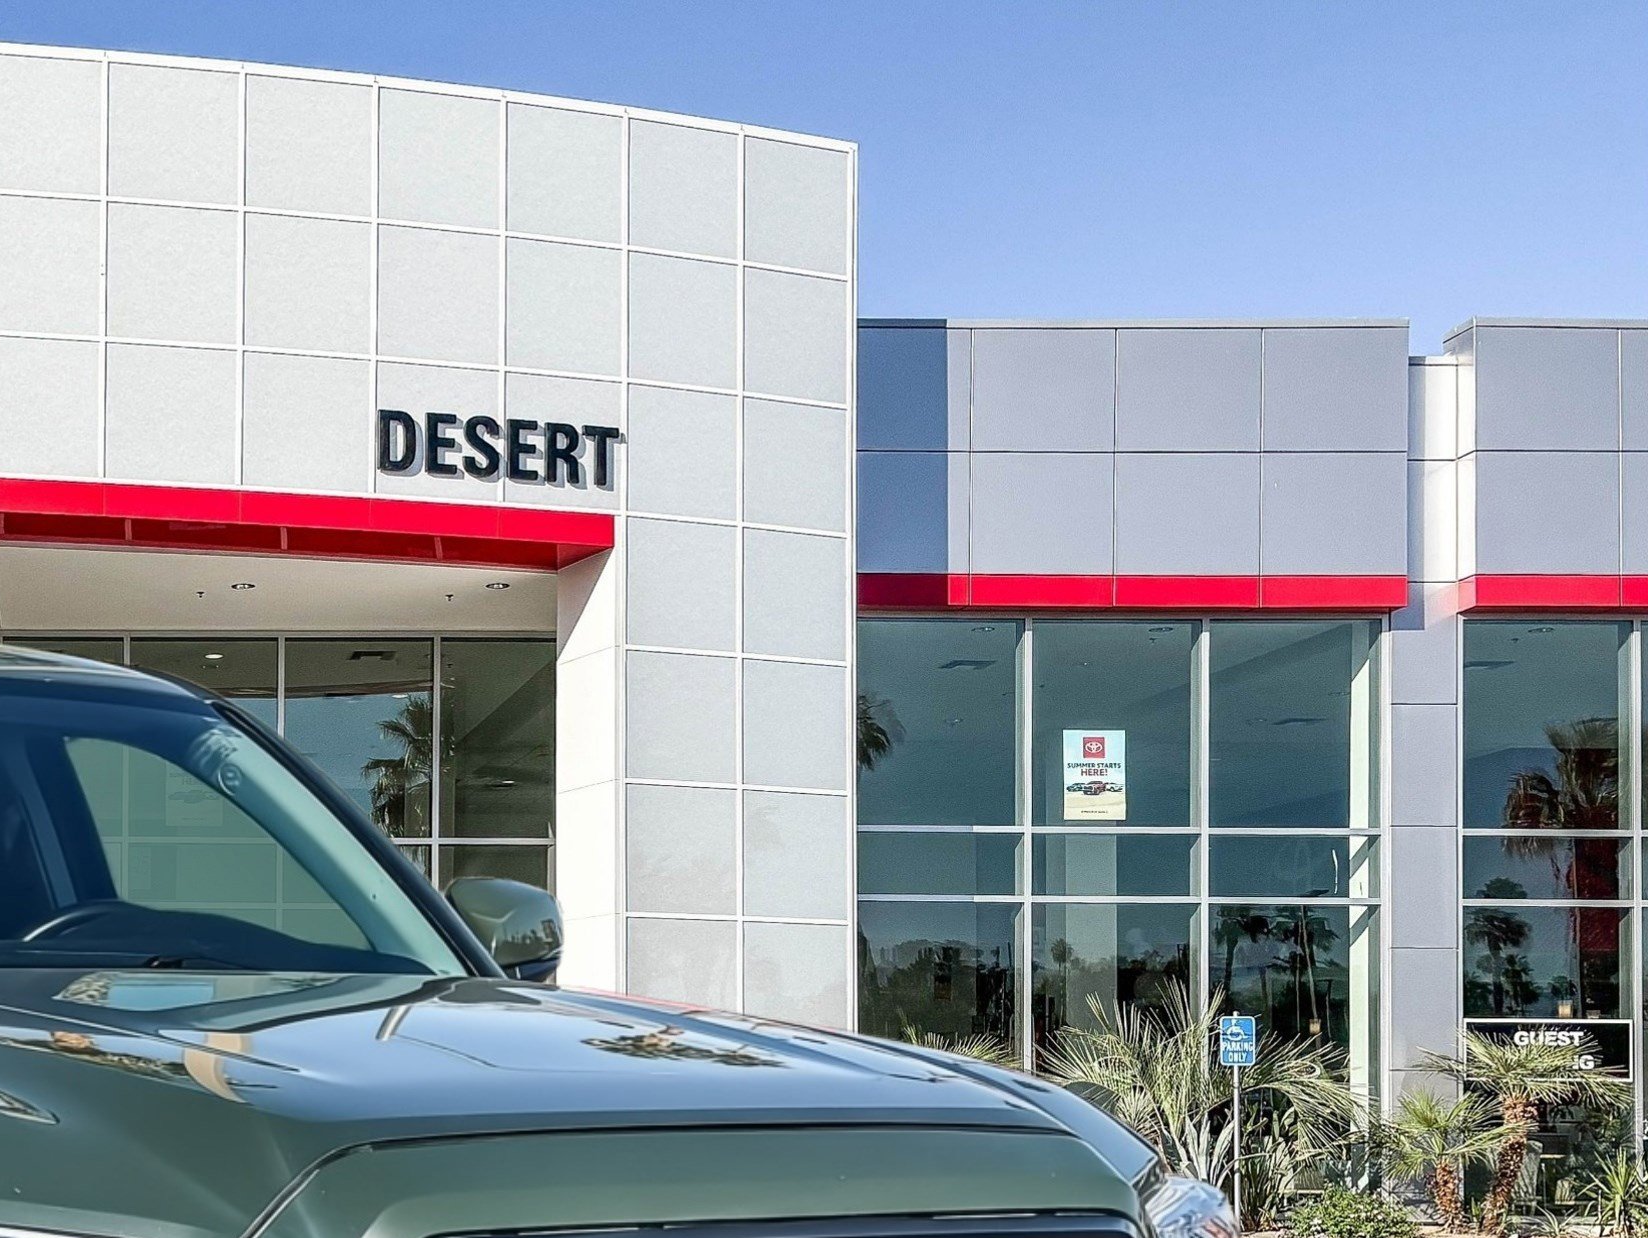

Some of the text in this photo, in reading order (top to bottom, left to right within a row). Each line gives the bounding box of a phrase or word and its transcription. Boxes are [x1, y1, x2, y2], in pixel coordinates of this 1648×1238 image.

[377, 409, 620, 487] DESERT
[1080, 768, 1108, 777] HERE!
[1513, 1030, 1584, 1047] GUEST
[1222, 1041, 1253, 1052] PARKING
[1228, 1051, 1247, 1063] ONLY
